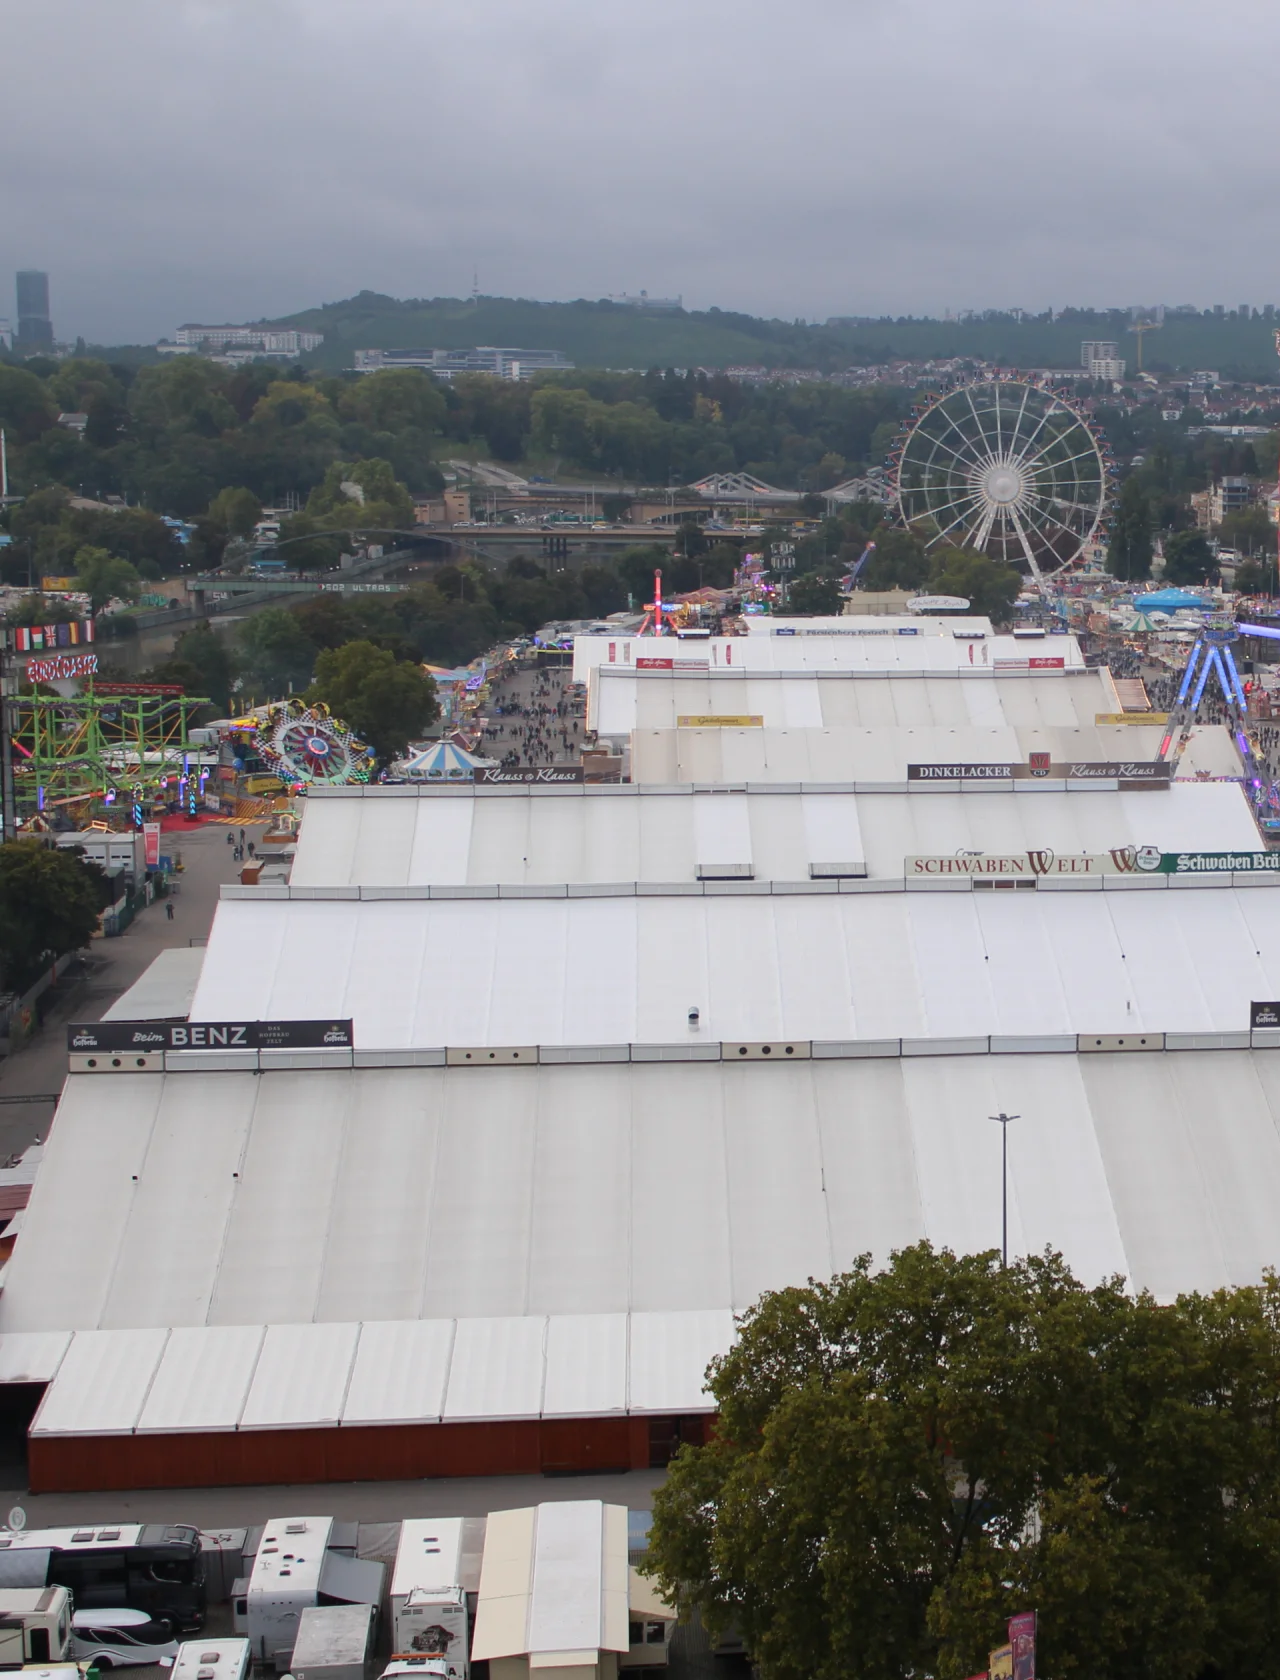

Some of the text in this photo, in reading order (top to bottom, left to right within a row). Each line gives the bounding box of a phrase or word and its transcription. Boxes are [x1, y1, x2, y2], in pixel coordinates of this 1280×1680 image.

[353, 584, 390, 592] ULTRAS
[483, 768, 523, 782] Klauss
[536, 768, 576, 781] Klauss
[920, 767, 1011, 777] DINKELACKER
[1070, 765, 1107, 777] Klauss
[1118, 764, 1155, 776] Klauss
[914, 859, 1024, 873] SCHWABEN
[1176, 854, 1251, 871] Schwaben
[132, 1027, 247, 1045] Beim BENZ
